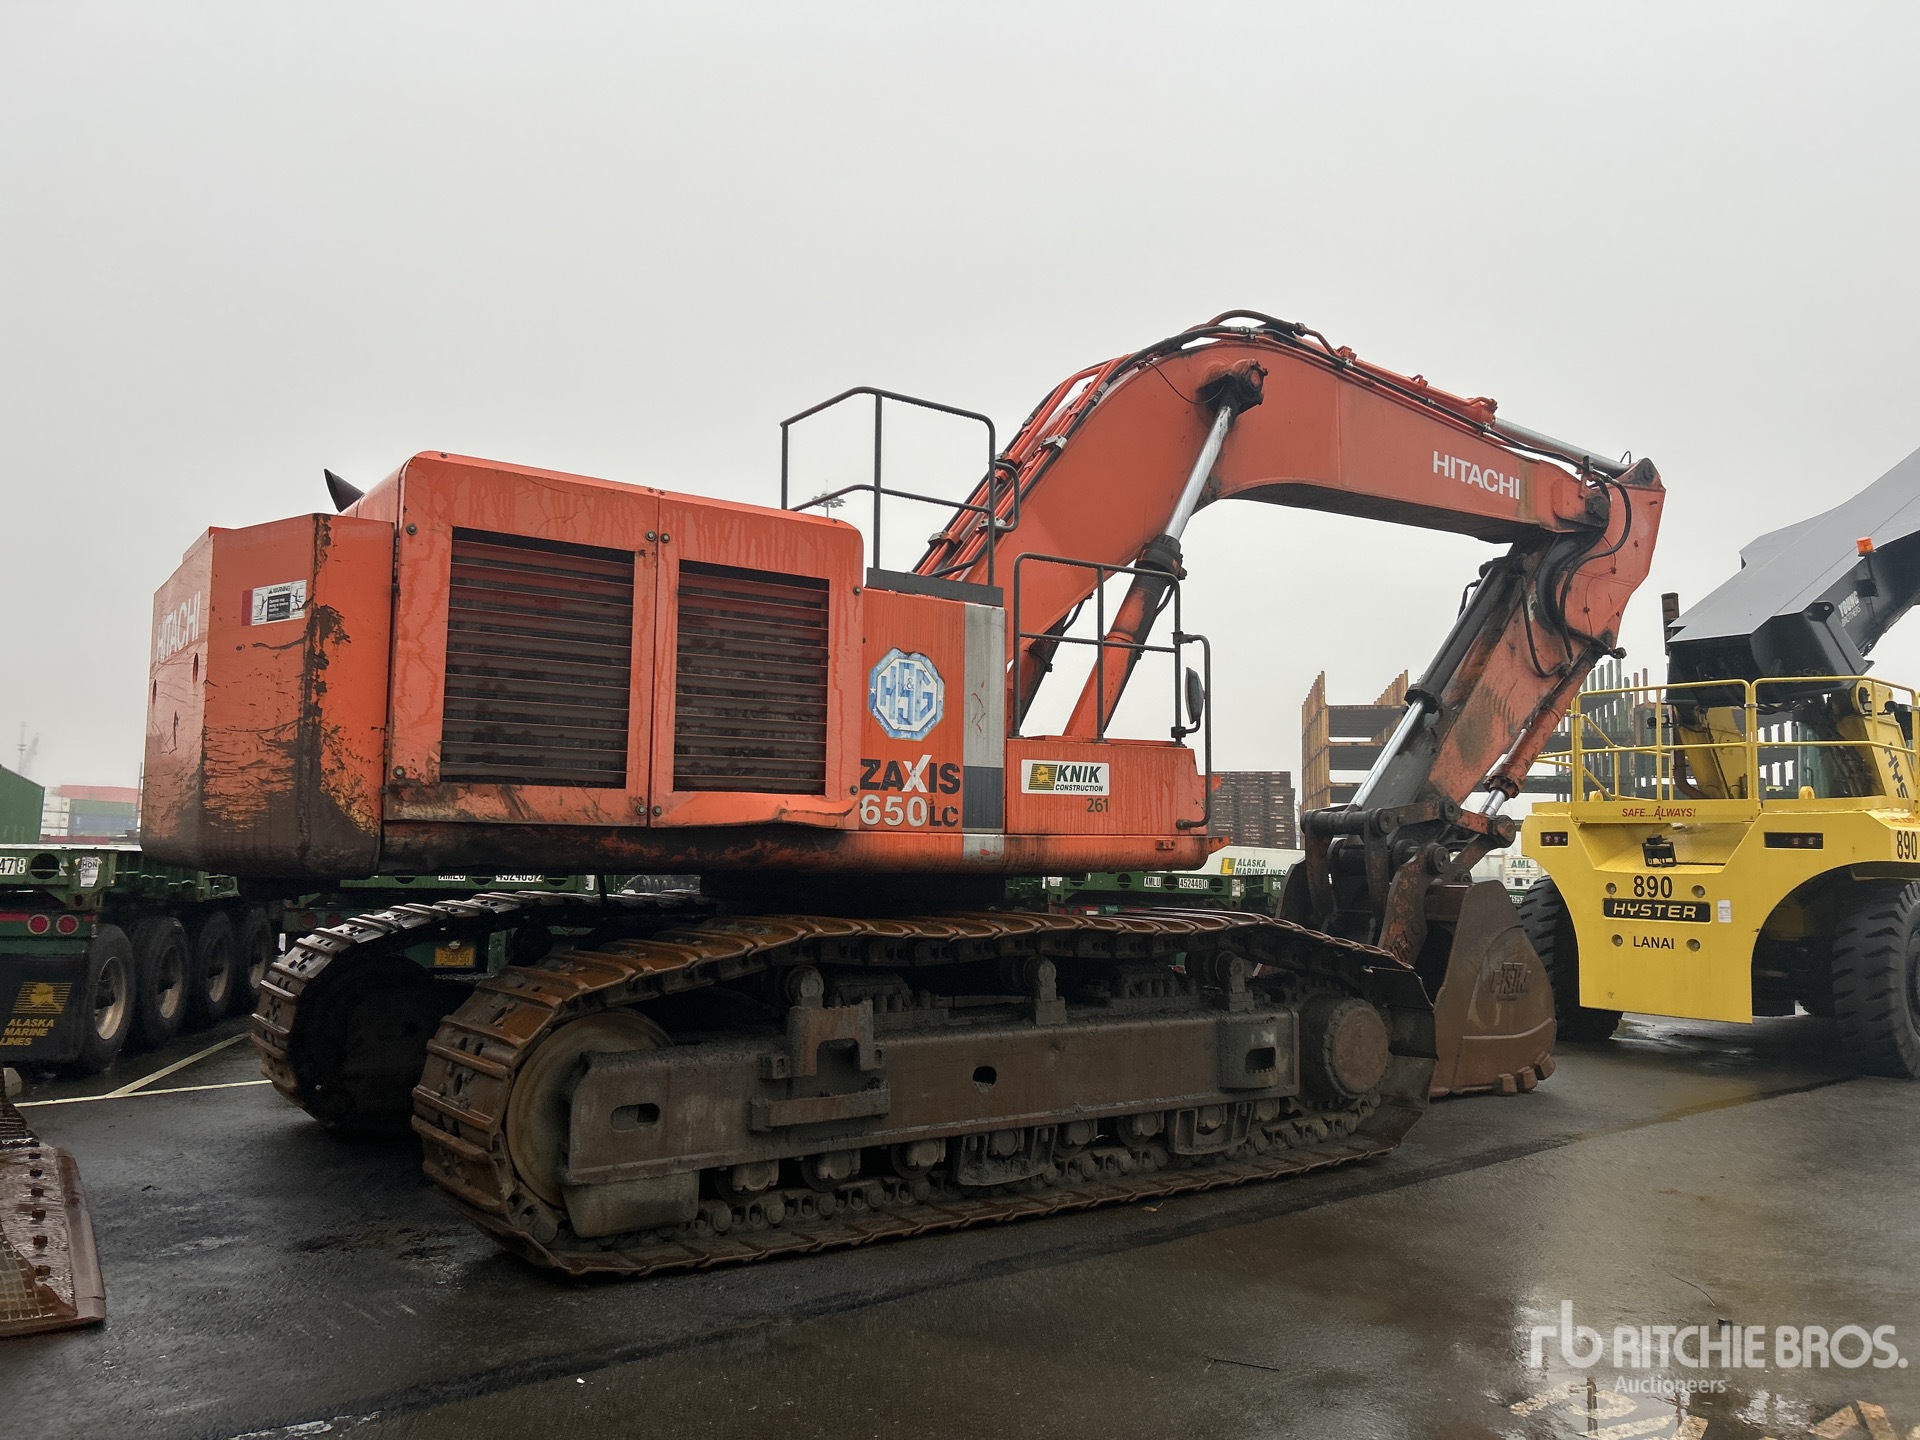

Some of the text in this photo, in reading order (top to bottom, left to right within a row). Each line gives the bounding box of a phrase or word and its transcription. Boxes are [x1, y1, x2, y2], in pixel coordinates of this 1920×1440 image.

[1433, 450, 1520, 500] HITACHI
[156, 590, 201, 665] HITACHI
[860, 754, 960, 795] ZAXIS
[1057, 764, 1102, 783] KNIK
[1055, 783, 1104, 793] CONSTRUCTION
[1086, 797, 1109, 813] 261
[1896, 829, 1918, 861] 890
[1237, 858, 1267, 868] ALASKA
[1510, 859, 1531, 869] AML
[1235, 867, 1264, 876] MARINE
[1633, 875, 1673, 899] 890
[1613, 902, 1697, 919] HYSTER
[1633, 935, 1675, 950] LANAI
[7, 1018, 55, 1028] ALASKA
[3, 1027, 49, 1037] MARINE
[0, 1037, 33, 1046] LINES
